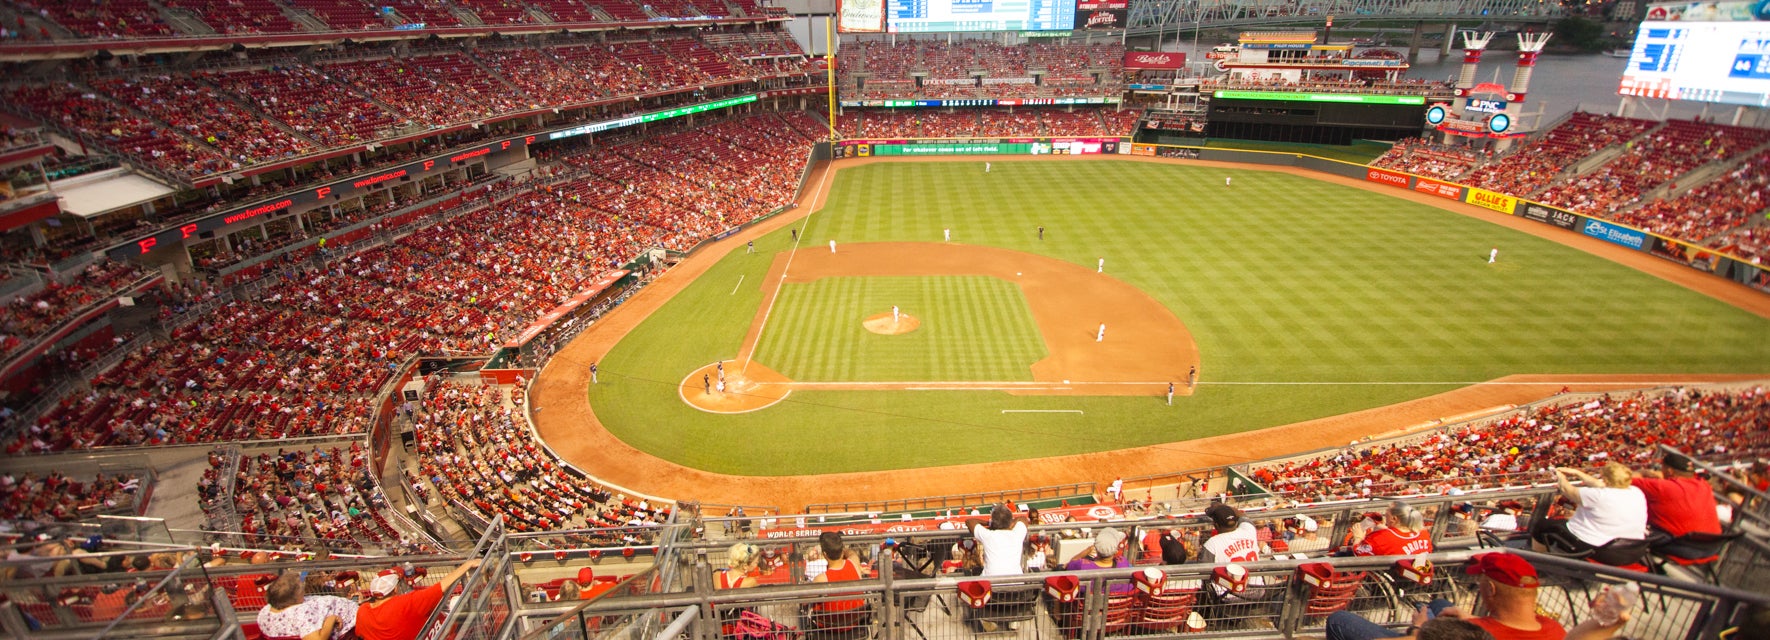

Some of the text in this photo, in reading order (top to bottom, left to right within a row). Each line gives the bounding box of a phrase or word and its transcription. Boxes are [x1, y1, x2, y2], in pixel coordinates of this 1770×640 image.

[1135, 54, 1170, 63] Reds
[1480, 100, 1500, 109] PNC
[451, 147, 491, 163] www.formica.com
[354, 169, 407, 188] www.formica.com
[1380, 173, 1407, 184] TOYOTA
[1475, 192, 1509, 208] OLLIE'S
[224, 199, 293, 225] www.formica.com
[1552, 211, 1576, 224] JACK
[1608, 229, 1643, 244] Elizabeth
[795, 529, 822, 537] SERIES
[1224, 539, 1255, 557] GRIFFEY
[1402, 540, 1428, 556] BRUCE
